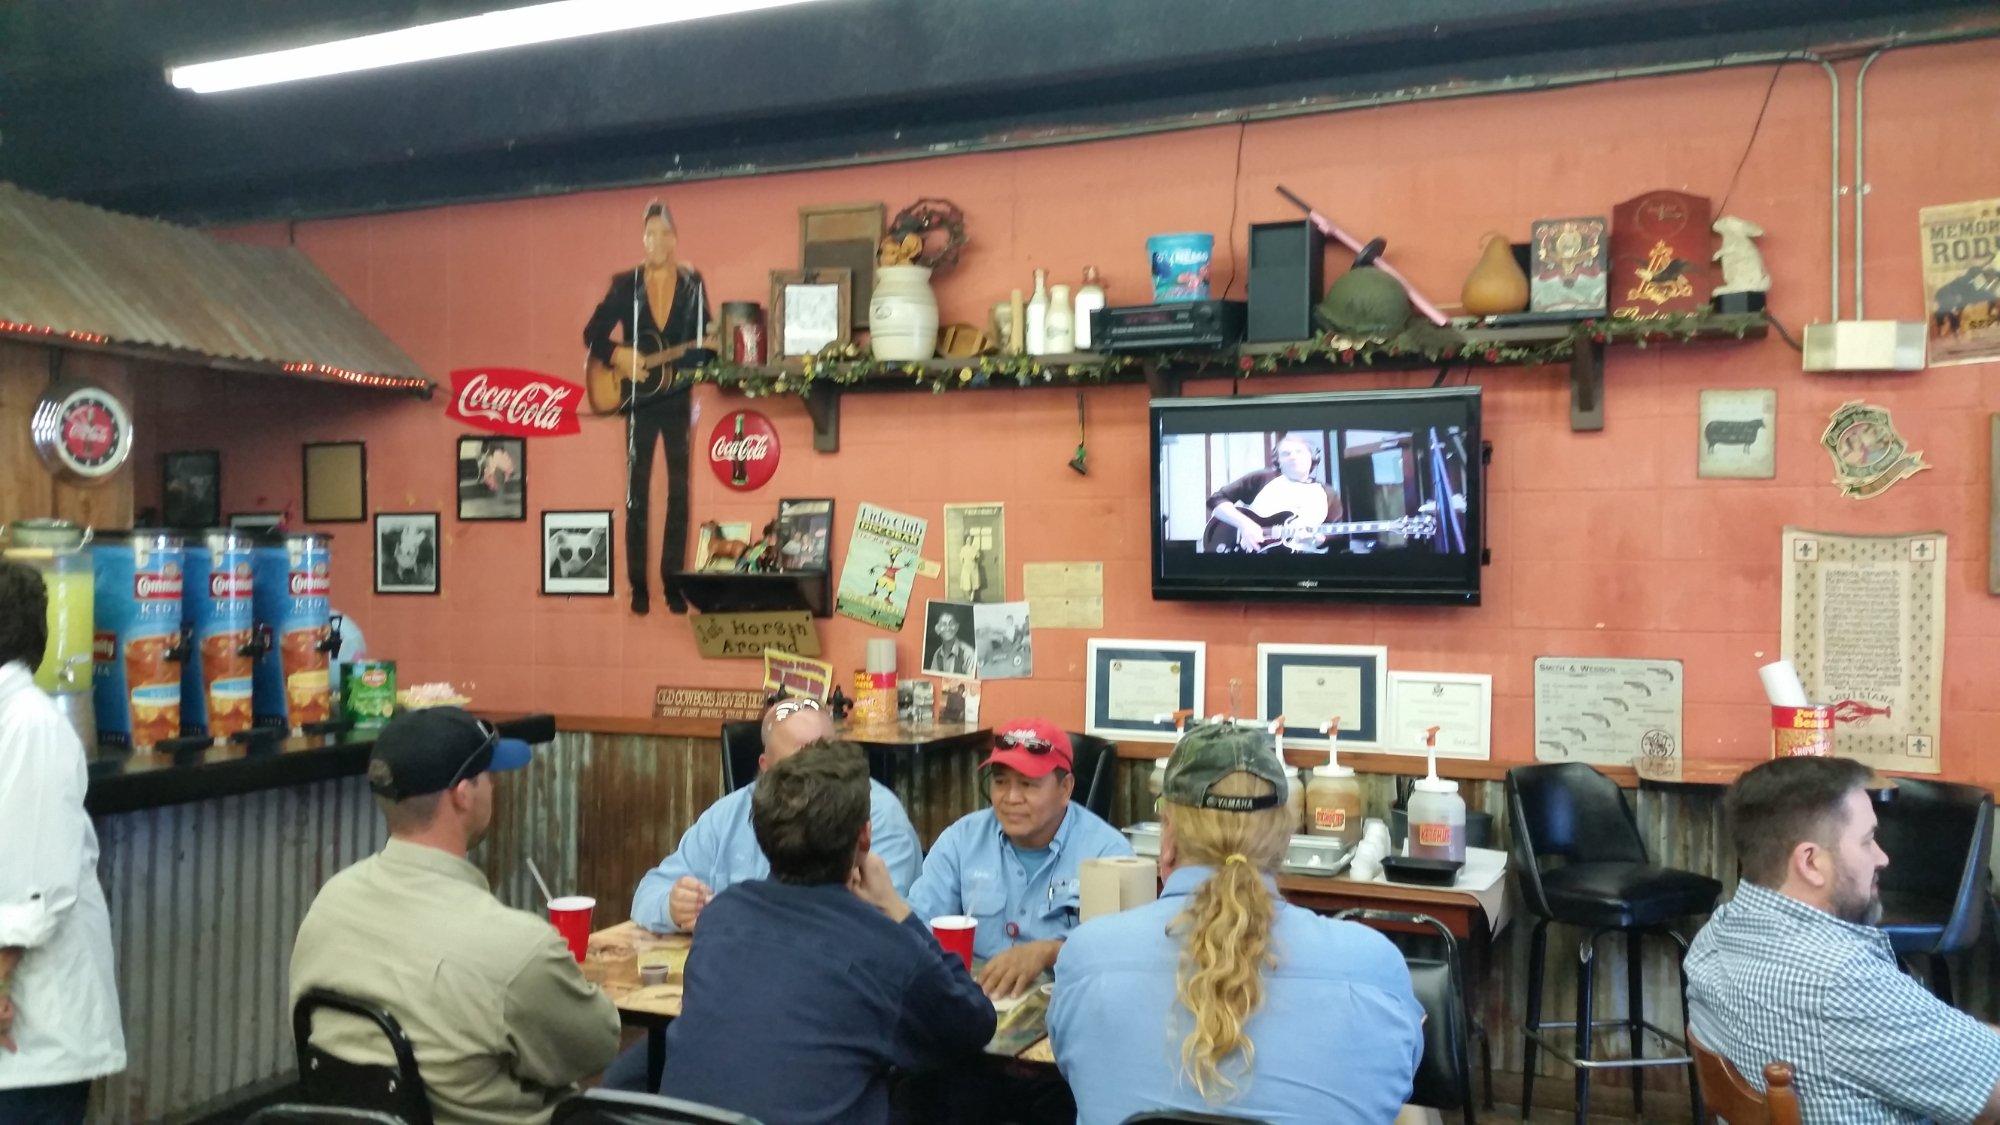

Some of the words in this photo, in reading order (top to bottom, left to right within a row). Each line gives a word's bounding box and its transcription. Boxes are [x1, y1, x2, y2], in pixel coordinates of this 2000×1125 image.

[458, 373, 571, 430] Coca-Cola
[711, 434, 768, 462] Coca-Cola
[1218, 798, 1253, 810] YAMAHA
